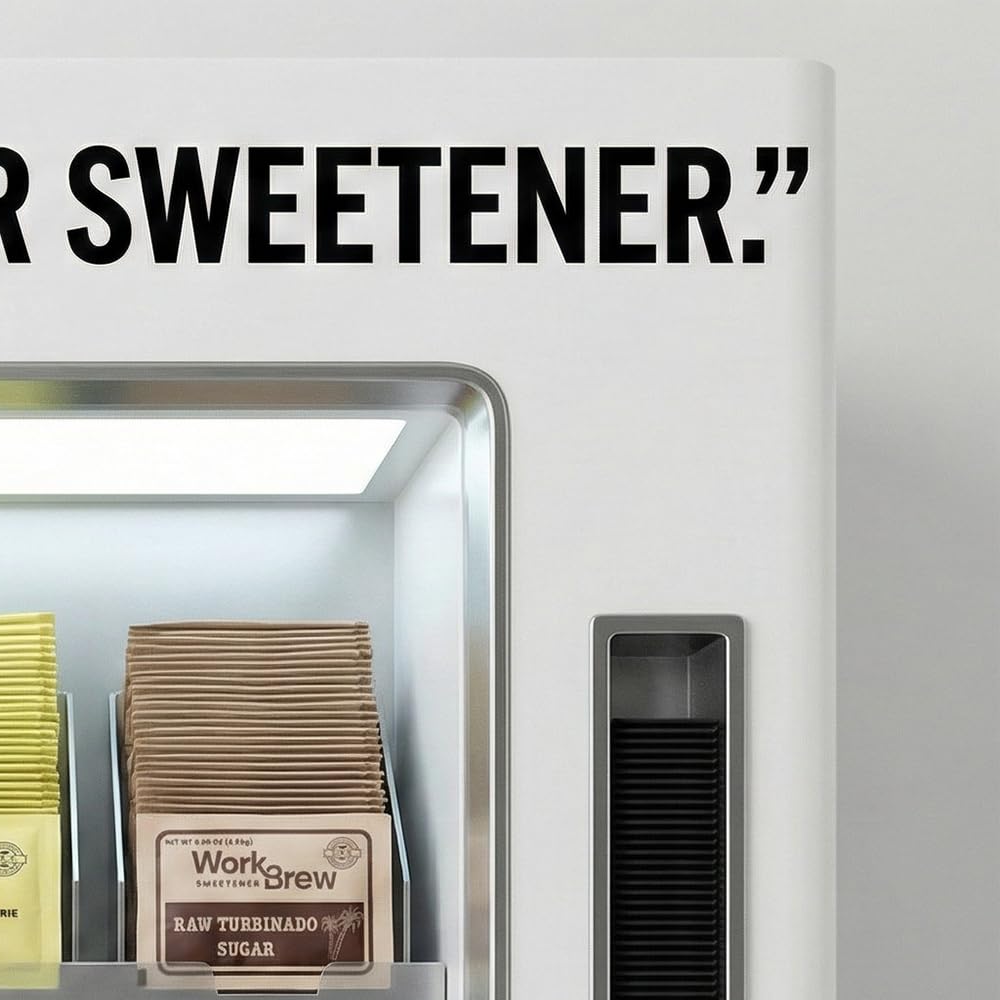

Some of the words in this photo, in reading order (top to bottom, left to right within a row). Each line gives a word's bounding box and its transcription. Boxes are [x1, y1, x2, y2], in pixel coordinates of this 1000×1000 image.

[191, 850, 338, 890] WorkBrew
[173, 916, 213, 932] RAW
[216, 916, 319, 933] TURBINADO
[216, 941, 276, 957] SUGAR
